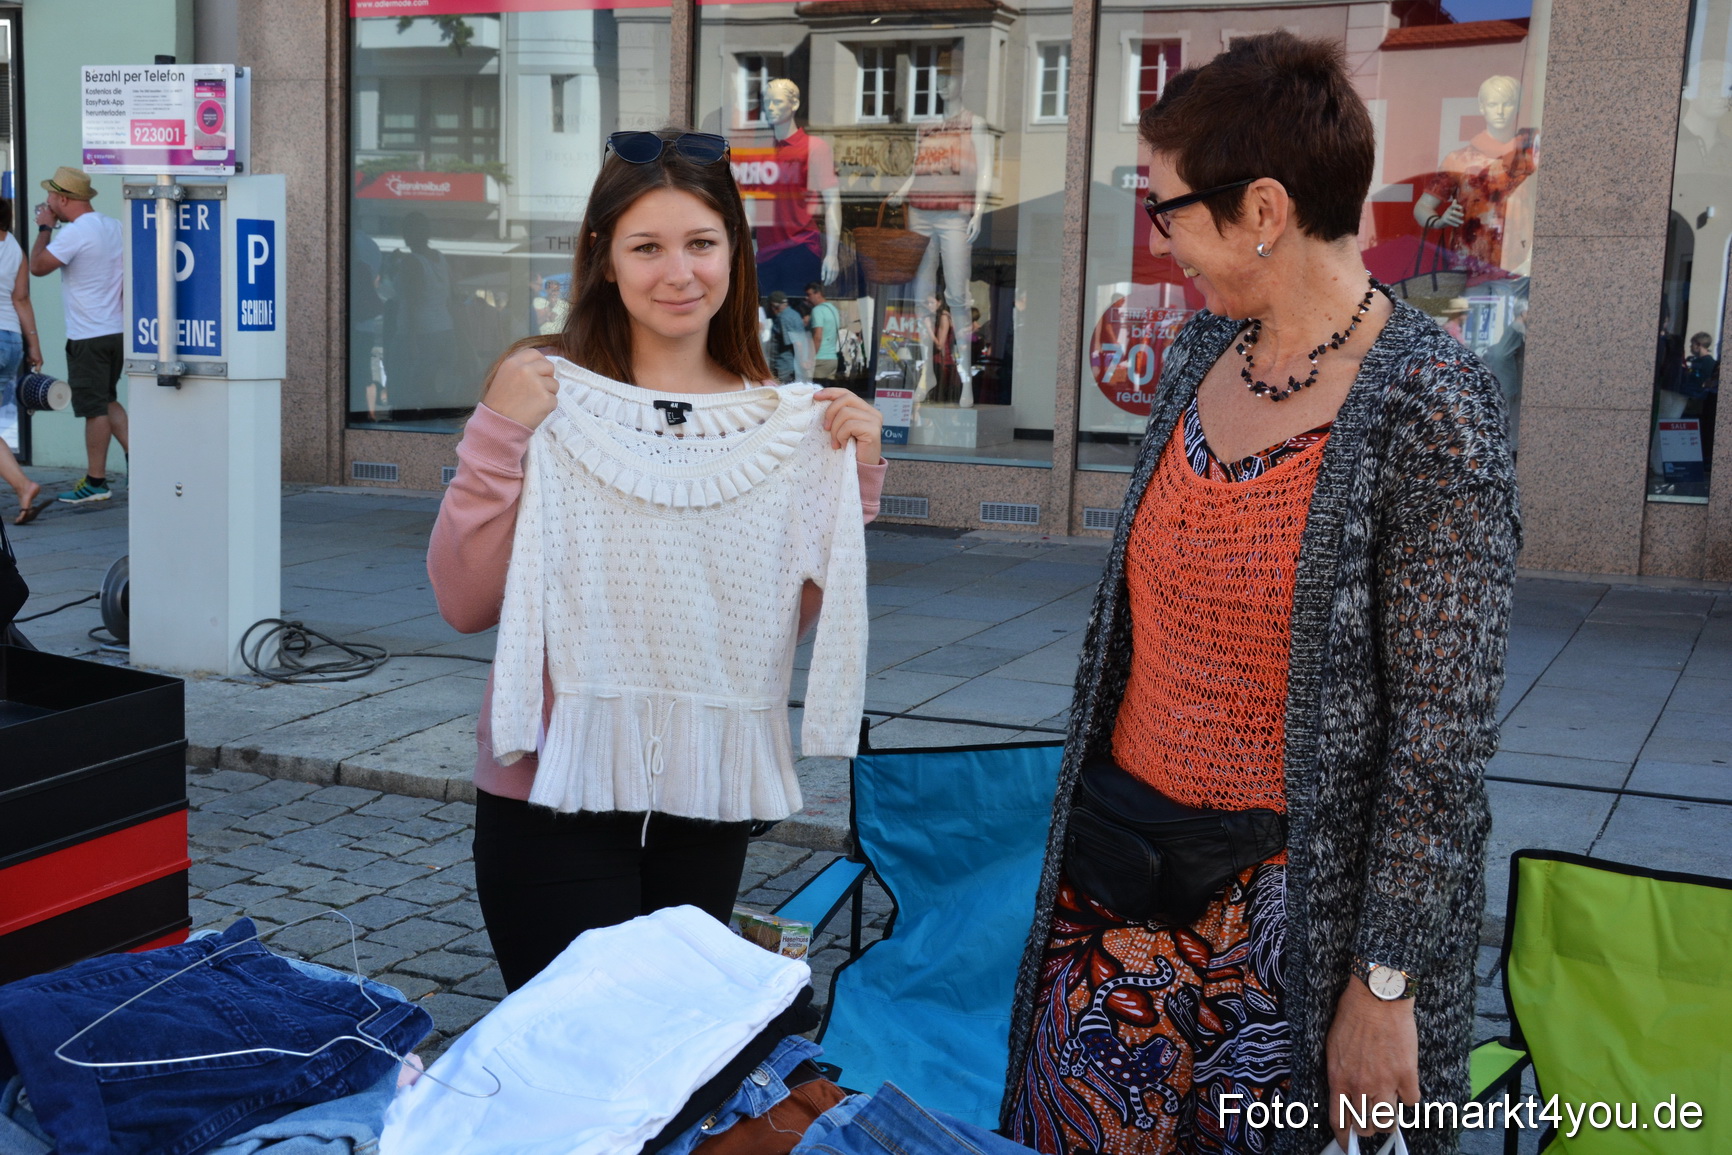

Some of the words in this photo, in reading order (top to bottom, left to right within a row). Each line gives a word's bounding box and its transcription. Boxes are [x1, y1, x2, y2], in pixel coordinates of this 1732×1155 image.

[85, 70, 121, 83] Bezahl
[124, 72, 142, 85] per
[144, 69, 186, 82] Telefon
[85, 99, 125, 107] EasyPark-App
[134, 127, 180, 143] 923001
[143, 204, 210, 230] HER
[248, 234, 270, 285] P
[138, 317, 216, 348] SCEINE
[1131, 324, 1153, 339] bis
[1157, 328, 1175, 339] zu
[1101, 343, 1169, 386] 70
